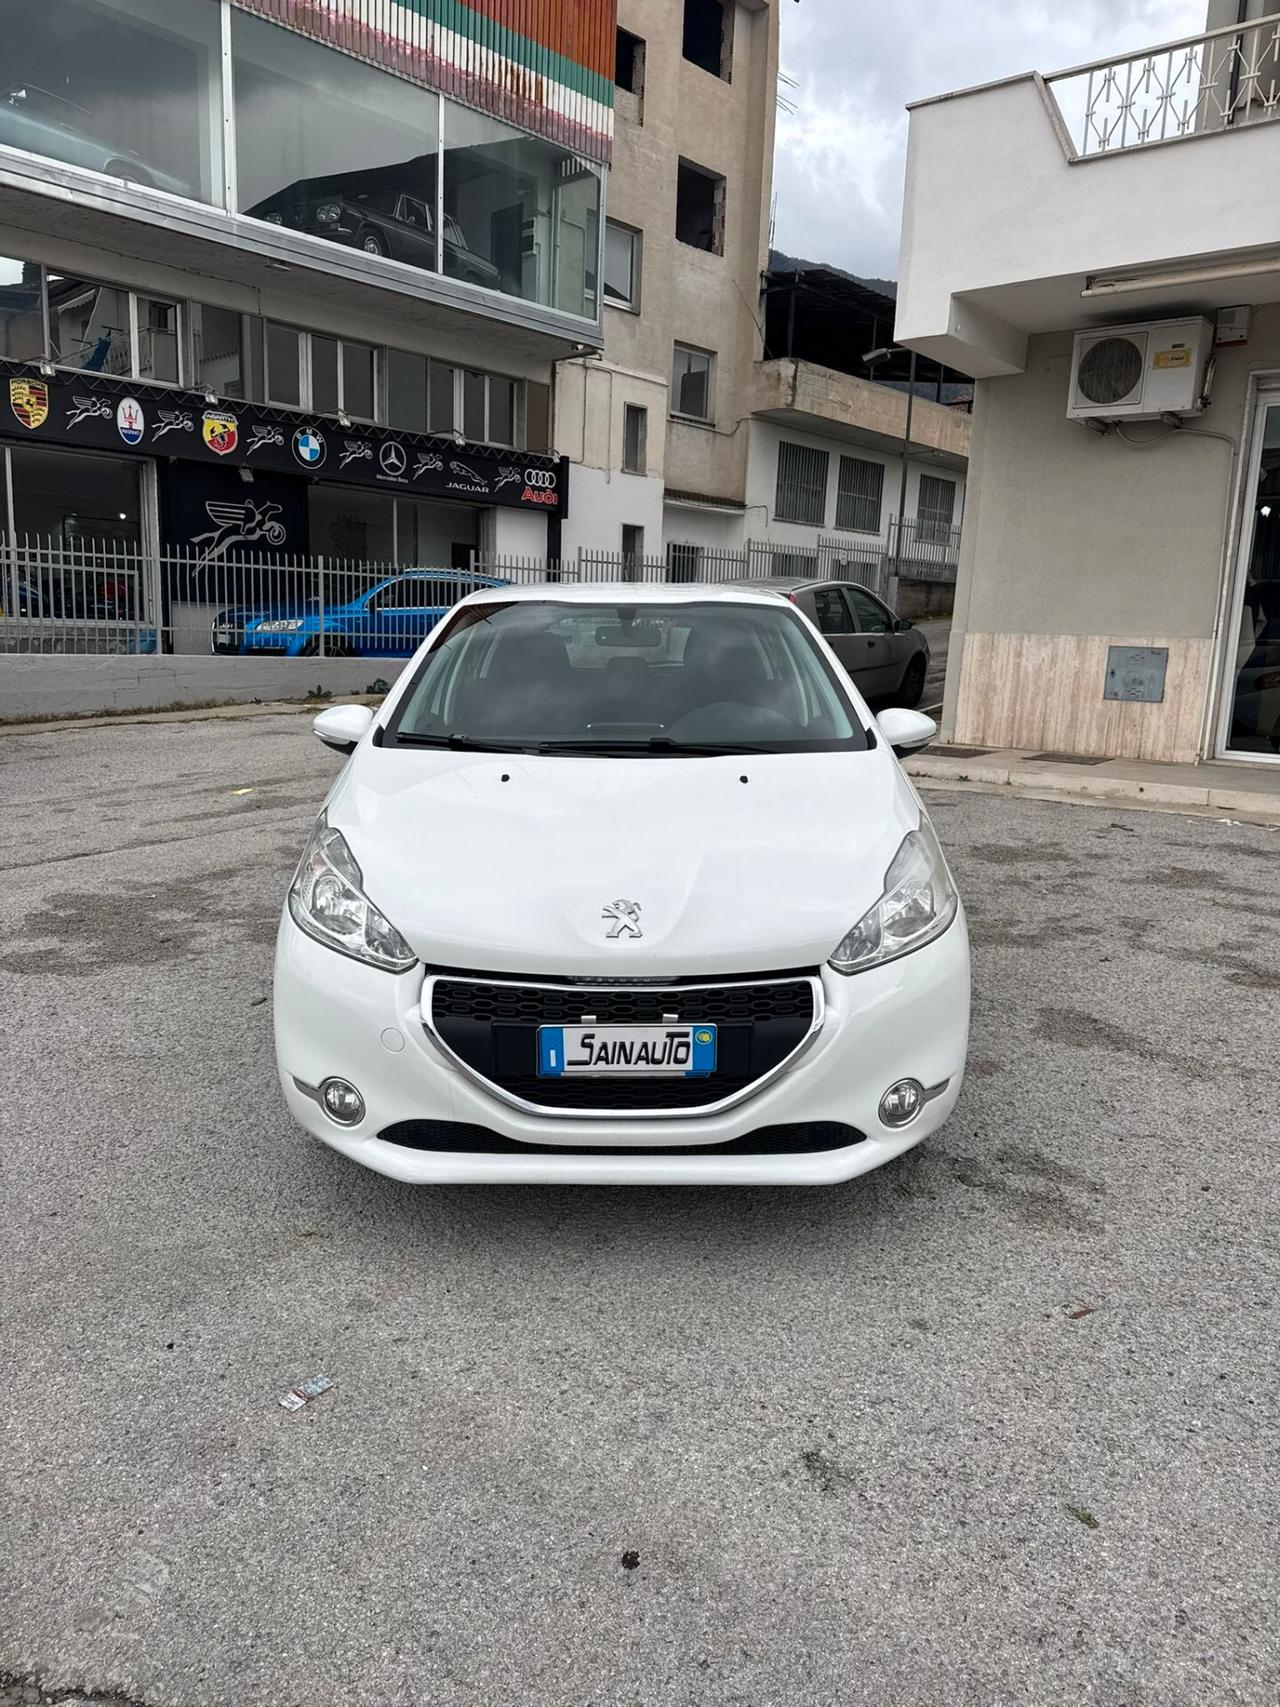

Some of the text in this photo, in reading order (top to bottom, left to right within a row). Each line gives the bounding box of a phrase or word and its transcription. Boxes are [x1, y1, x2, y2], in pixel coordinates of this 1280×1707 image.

[445, 482, 489, 493] JAGUAR
[521, 485, 558, 505] Audi
[566, 1031, 691, 1066] SAINAUTO
